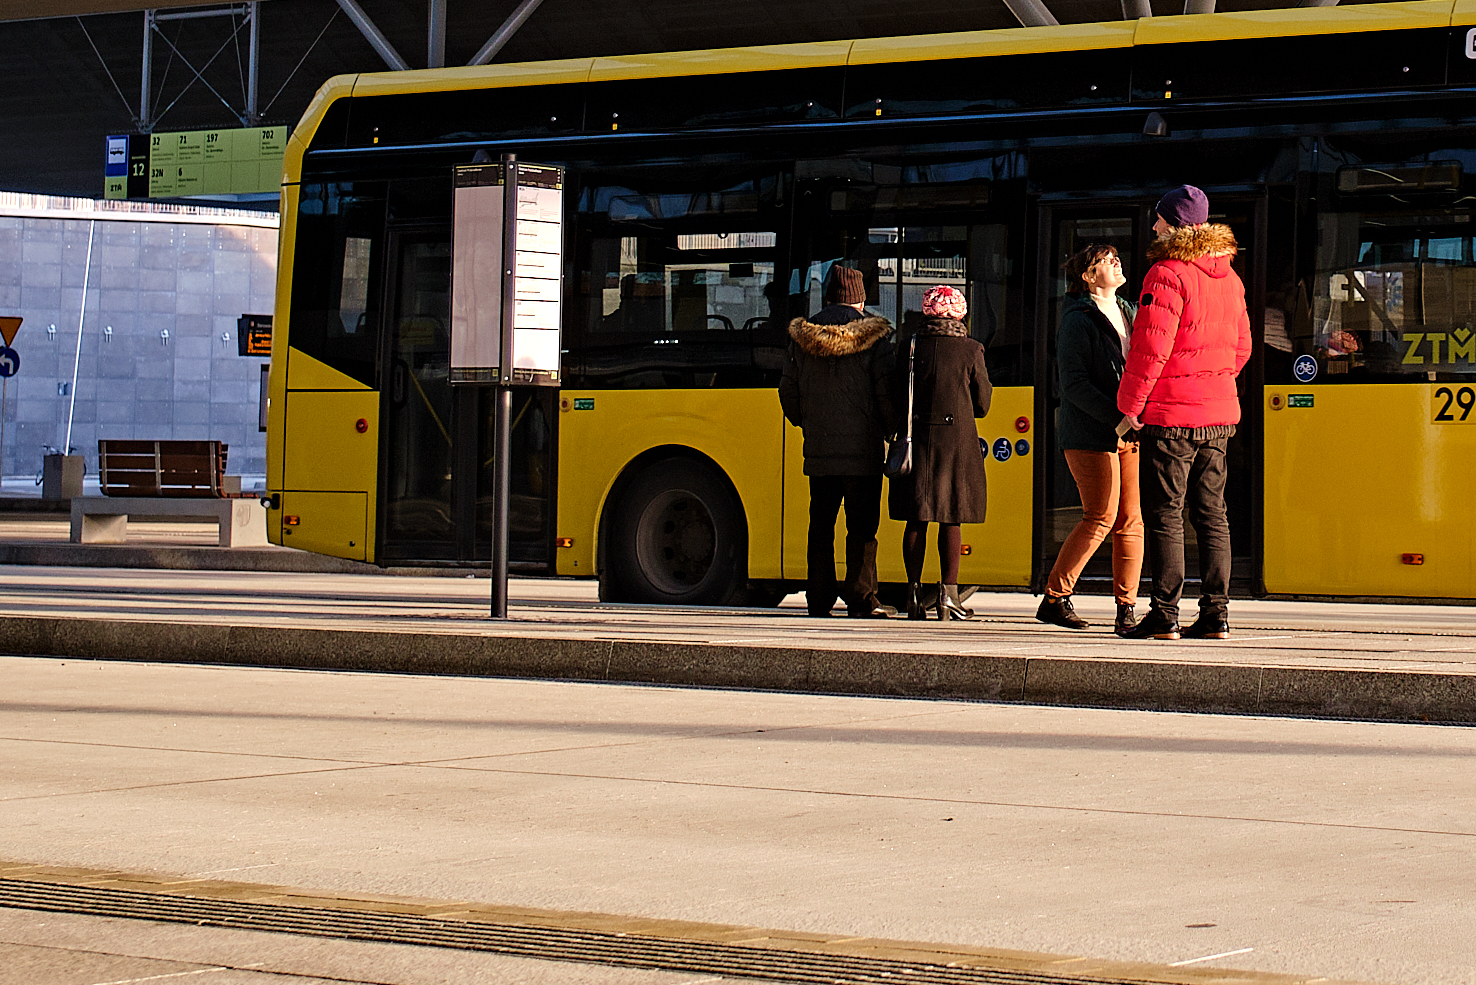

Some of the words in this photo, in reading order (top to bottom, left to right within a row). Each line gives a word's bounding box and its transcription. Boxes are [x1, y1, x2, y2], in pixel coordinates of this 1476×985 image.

[206, 134, 218, 142] 197
[262, 130, 274, 140] 702
[132, 163, 144, 176] 12
[1402, 328, 1476, 364] ZTM
